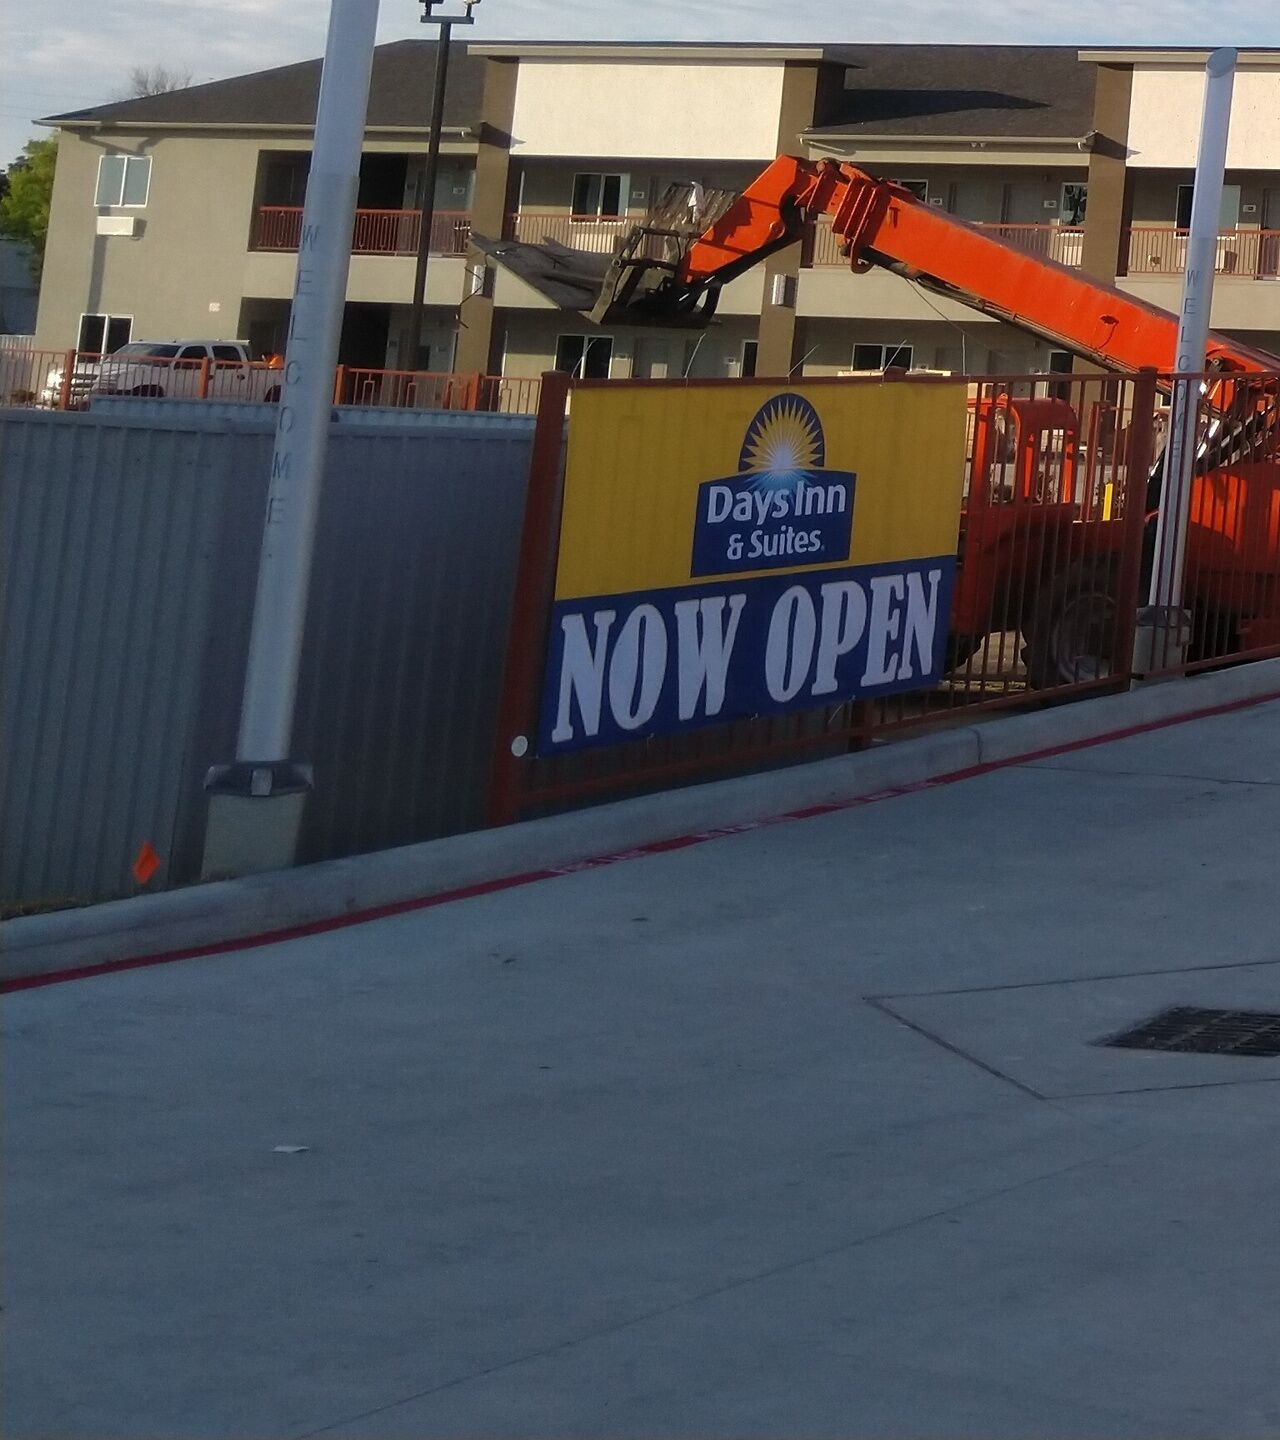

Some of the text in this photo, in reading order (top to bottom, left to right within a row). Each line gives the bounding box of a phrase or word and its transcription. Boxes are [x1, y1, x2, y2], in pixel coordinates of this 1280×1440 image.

[266, 223, 320, 524] WELCOME
[706, 480, 847, 526] Days Inn
[726, 526, 822, 561] & Suites
[551, 568, 942, 744] NOW OPEN
